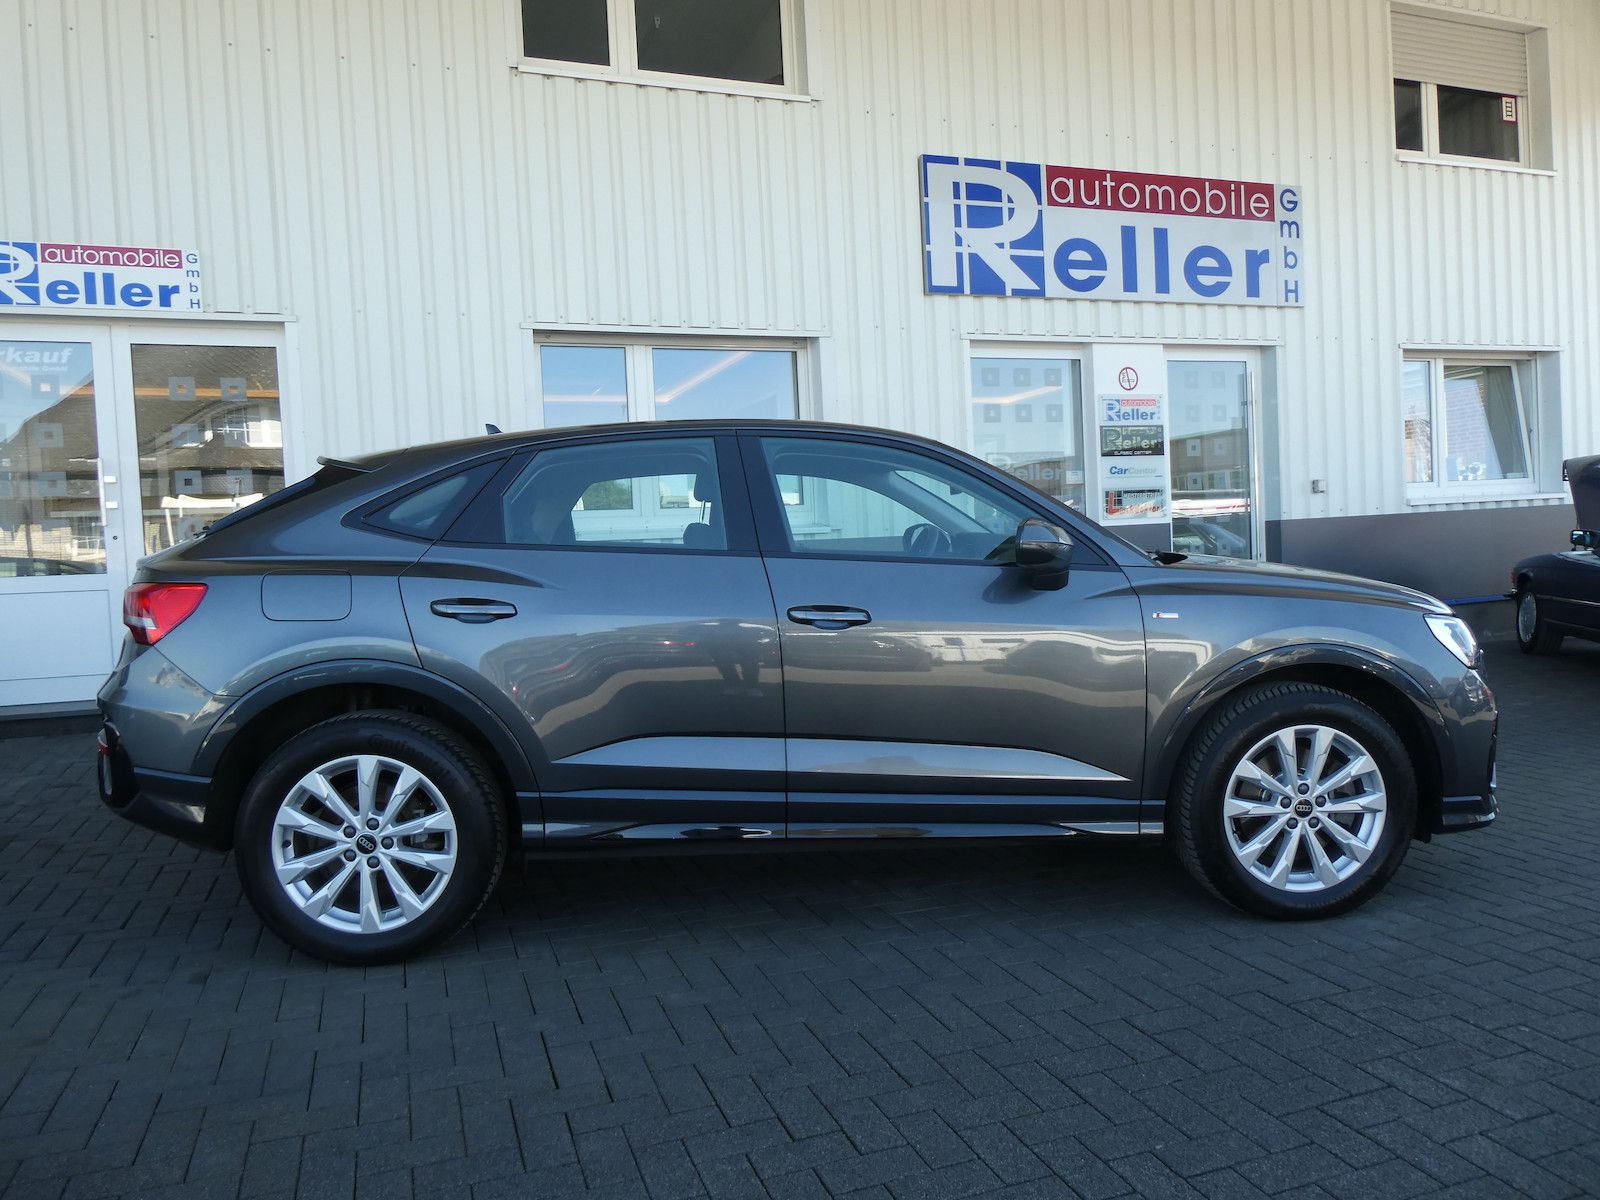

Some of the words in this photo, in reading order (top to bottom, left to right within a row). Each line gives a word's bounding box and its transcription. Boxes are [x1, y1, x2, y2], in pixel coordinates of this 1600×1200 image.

[1050, 173, 1270, 218] automobile
[926, 162, 1270, 298] Reller
[1279, 187, 1300, 304] GmbH
[44, 245, 180, 268] automobile
[186, 253, 201, 309] GmbH
[1102, 399, 1156, 421] Reller
